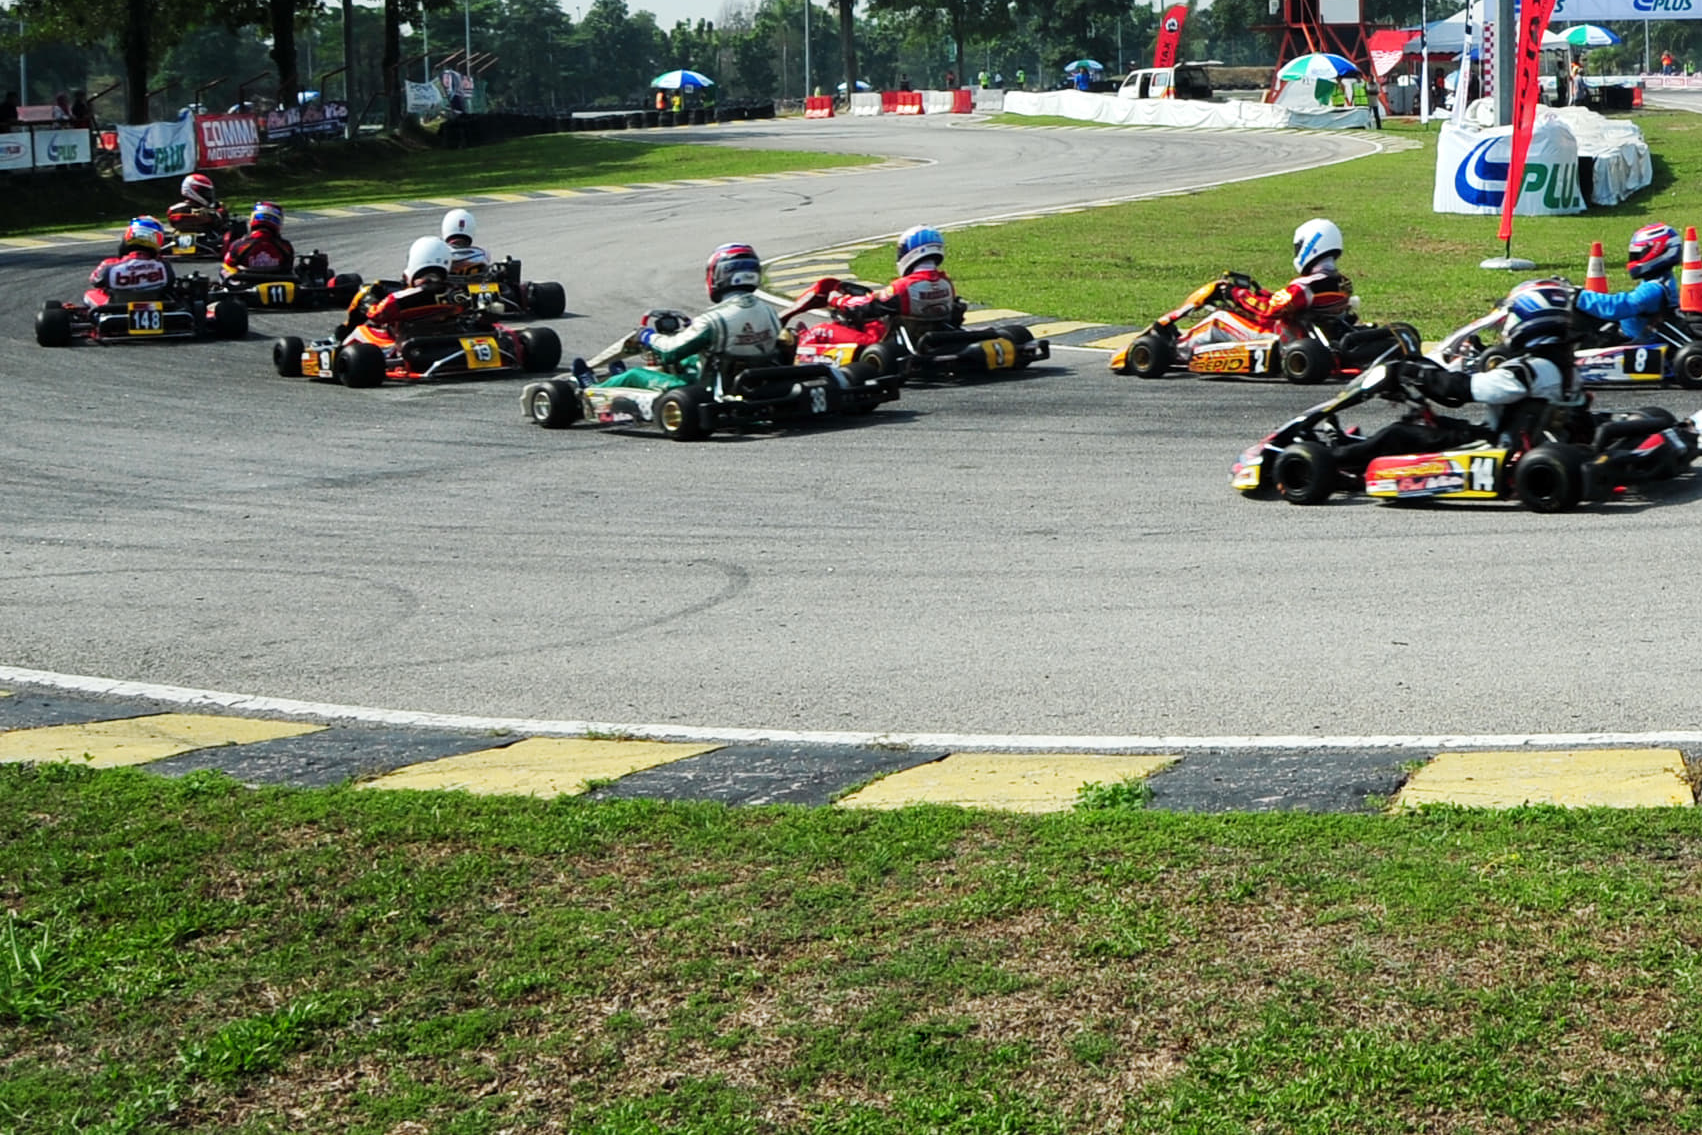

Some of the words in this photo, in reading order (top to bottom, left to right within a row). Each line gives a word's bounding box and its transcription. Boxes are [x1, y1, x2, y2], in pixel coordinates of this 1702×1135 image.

[201, 119, 259, 147] COMMA
[1510, 163, 1580, 209] PLU
[115, 268, 165, 286] birel
[270, 286, 284, 304] 11
[133, 311, 161, 330] 148
[1254, 347, 1265, 374] 2
[1633, 346, 1648, 373] 8
